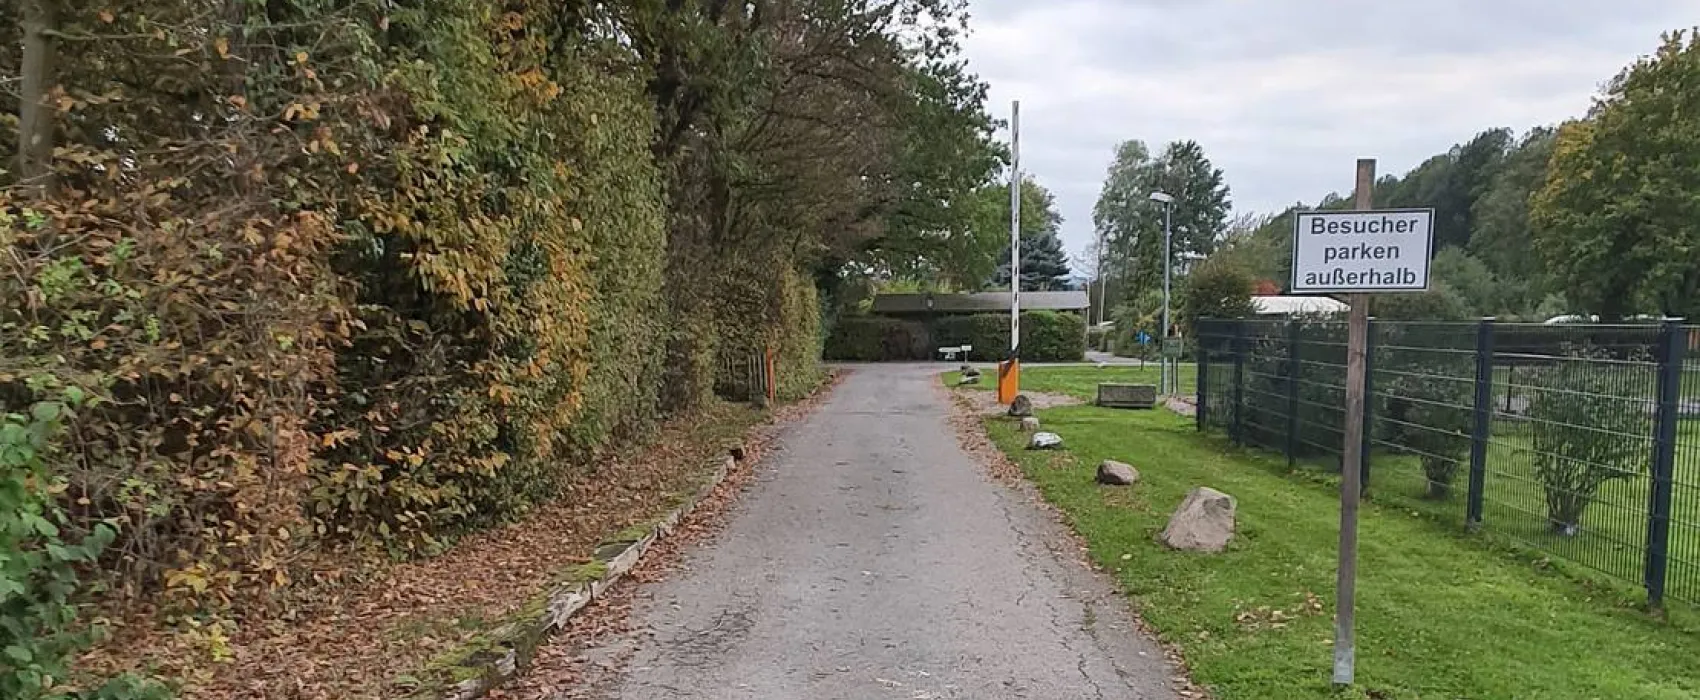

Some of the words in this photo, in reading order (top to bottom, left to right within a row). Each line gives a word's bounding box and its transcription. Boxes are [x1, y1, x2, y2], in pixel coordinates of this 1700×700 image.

[1311, 216, 1418, 234] Besucher
[1324, 242, 1399, 263] parken
[1305, 267, 1416, 285] außerhalb
